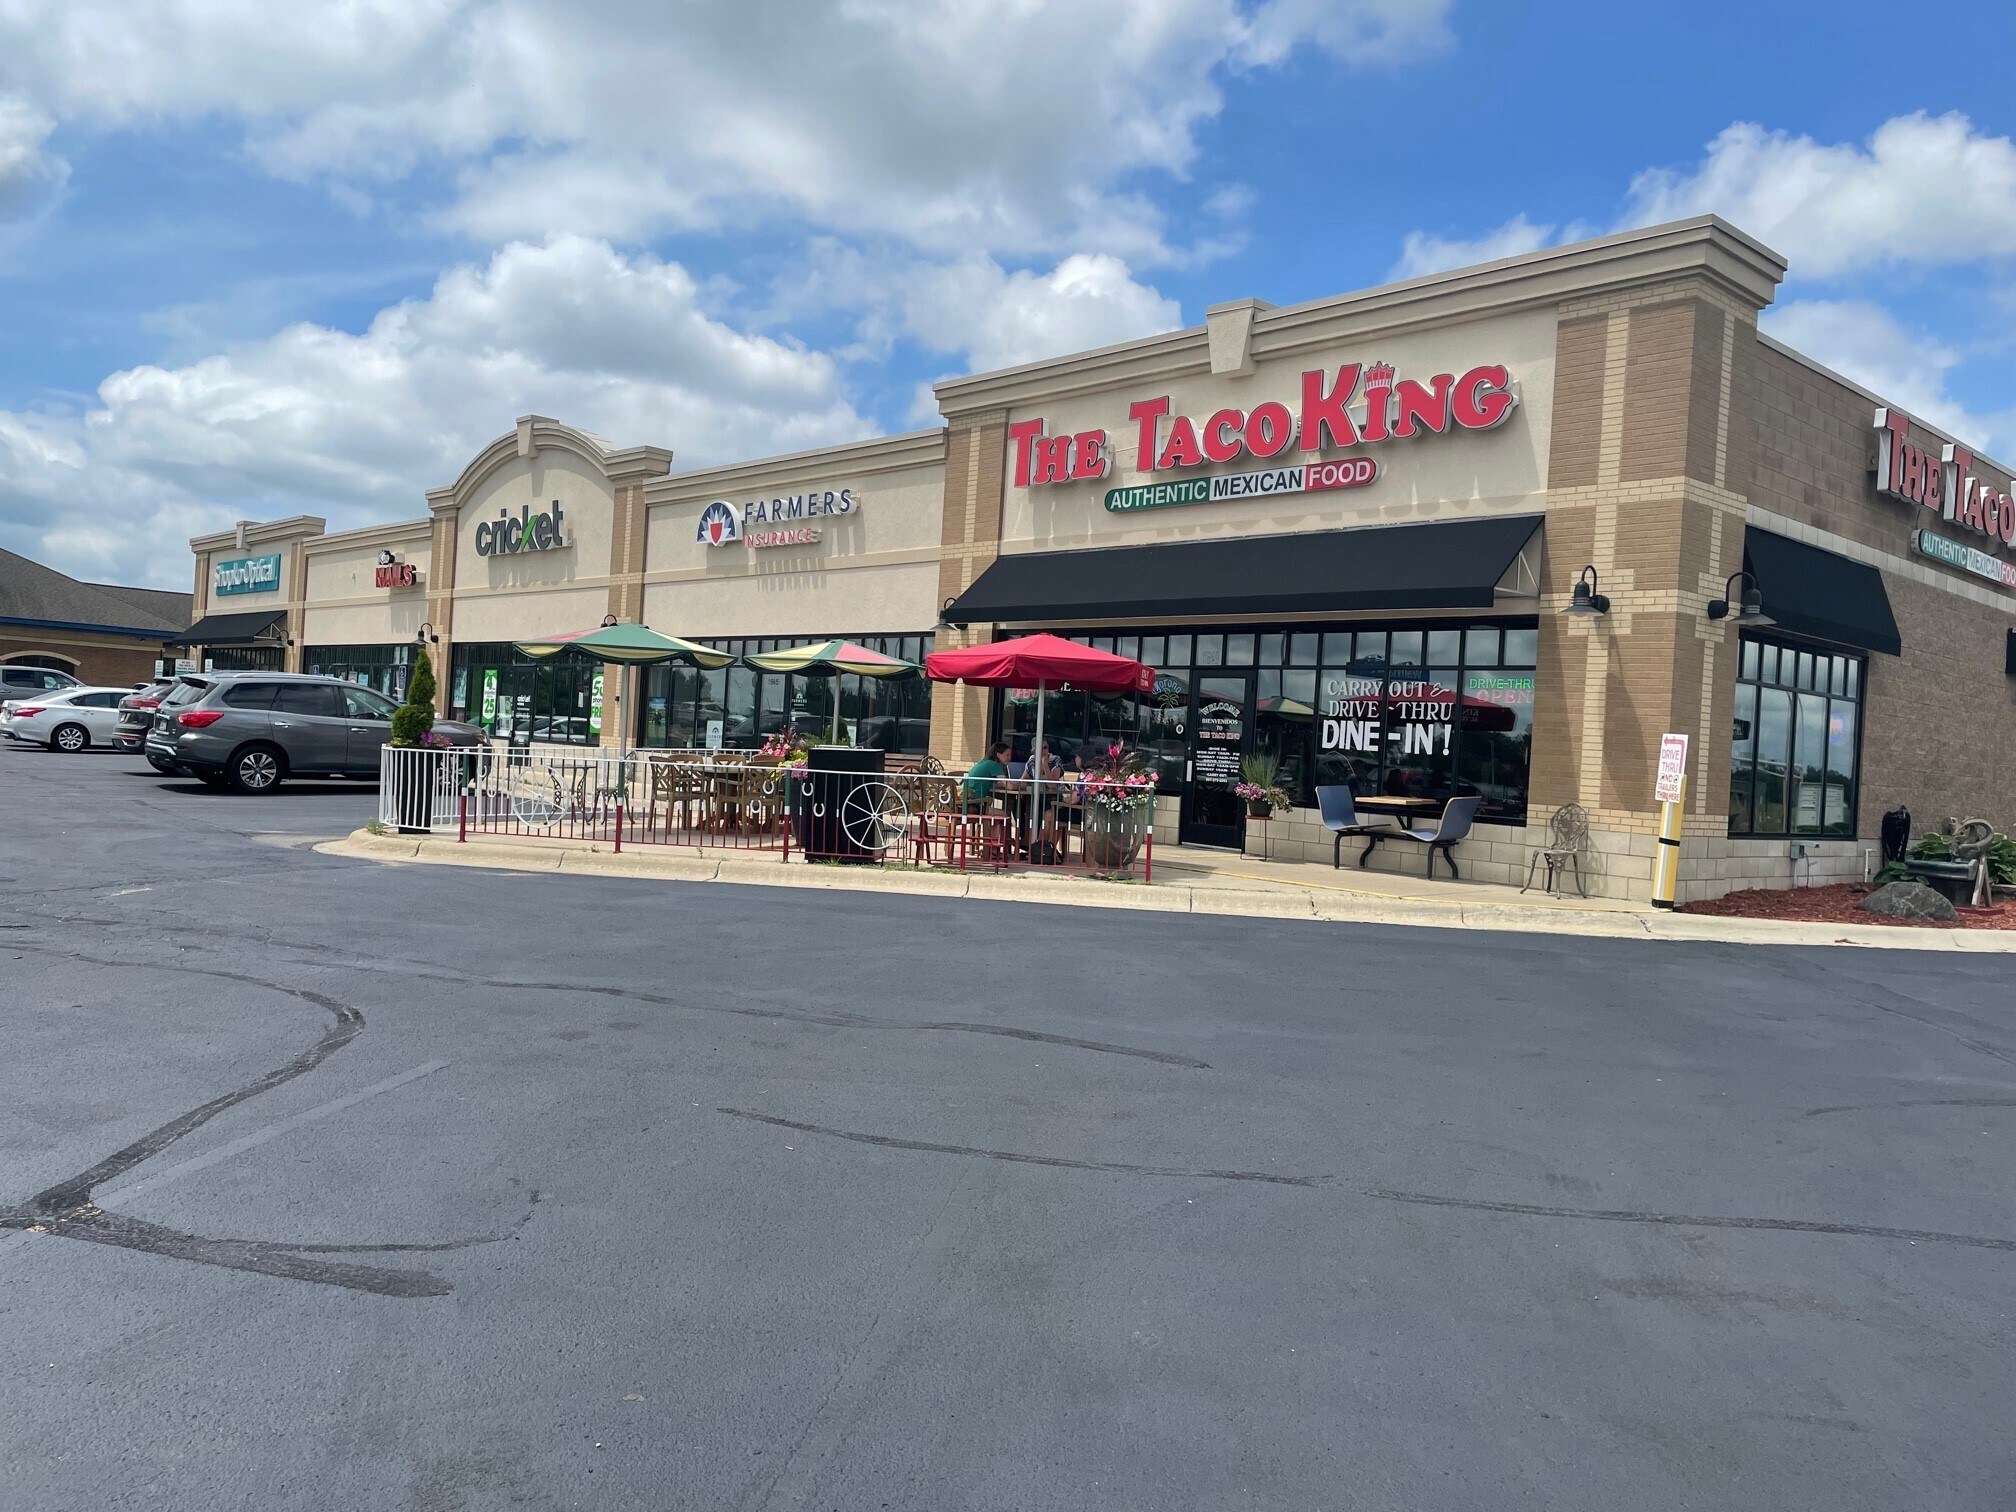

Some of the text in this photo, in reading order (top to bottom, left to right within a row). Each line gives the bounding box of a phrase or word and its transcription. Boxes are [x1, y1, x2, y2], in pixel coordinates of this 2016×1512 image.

[1009, 417, 1108, 488] THE
[1886, 408, 2016, 543] THE TACO
[1110, 460, 1371, 510] AUTHENTIC MEXICAN FOOD
[744, 489, 851, 525] FARMERS
[476, 500, 564, 556] cricket
[744, 528, 812, 548] INSURANCE
[1922, 532, 2016, 585] AUTHENTIC MEXICAN FOO
[376, 565, 414, 588] NAILS
[1151, 678, 1182, 695] Corona
[1327, 680, 1384, 698] CARRY
[1388, 681, 1427, 698] OUT
[1475, 689, 1531, 704] OPEN
[484, 698, 495, 714] 25
[591, 706, 602, 718] FRE
[1200, 702, 1240, 718] WELCOME
[1328, 700, 1380, 719] DRIVE
[1199, 731, 1211, 739] THE
[1211, 732, 1226, 740] TACO
[1321, 719, 1381, 751] DINE
[1661, 748, 1680, 760] DRIVE
[1661, 761, 1679, 774] THRU
[1657, 782, 1678, 792] TRAILERS
[1668, 793, 1680, 802] HERE
